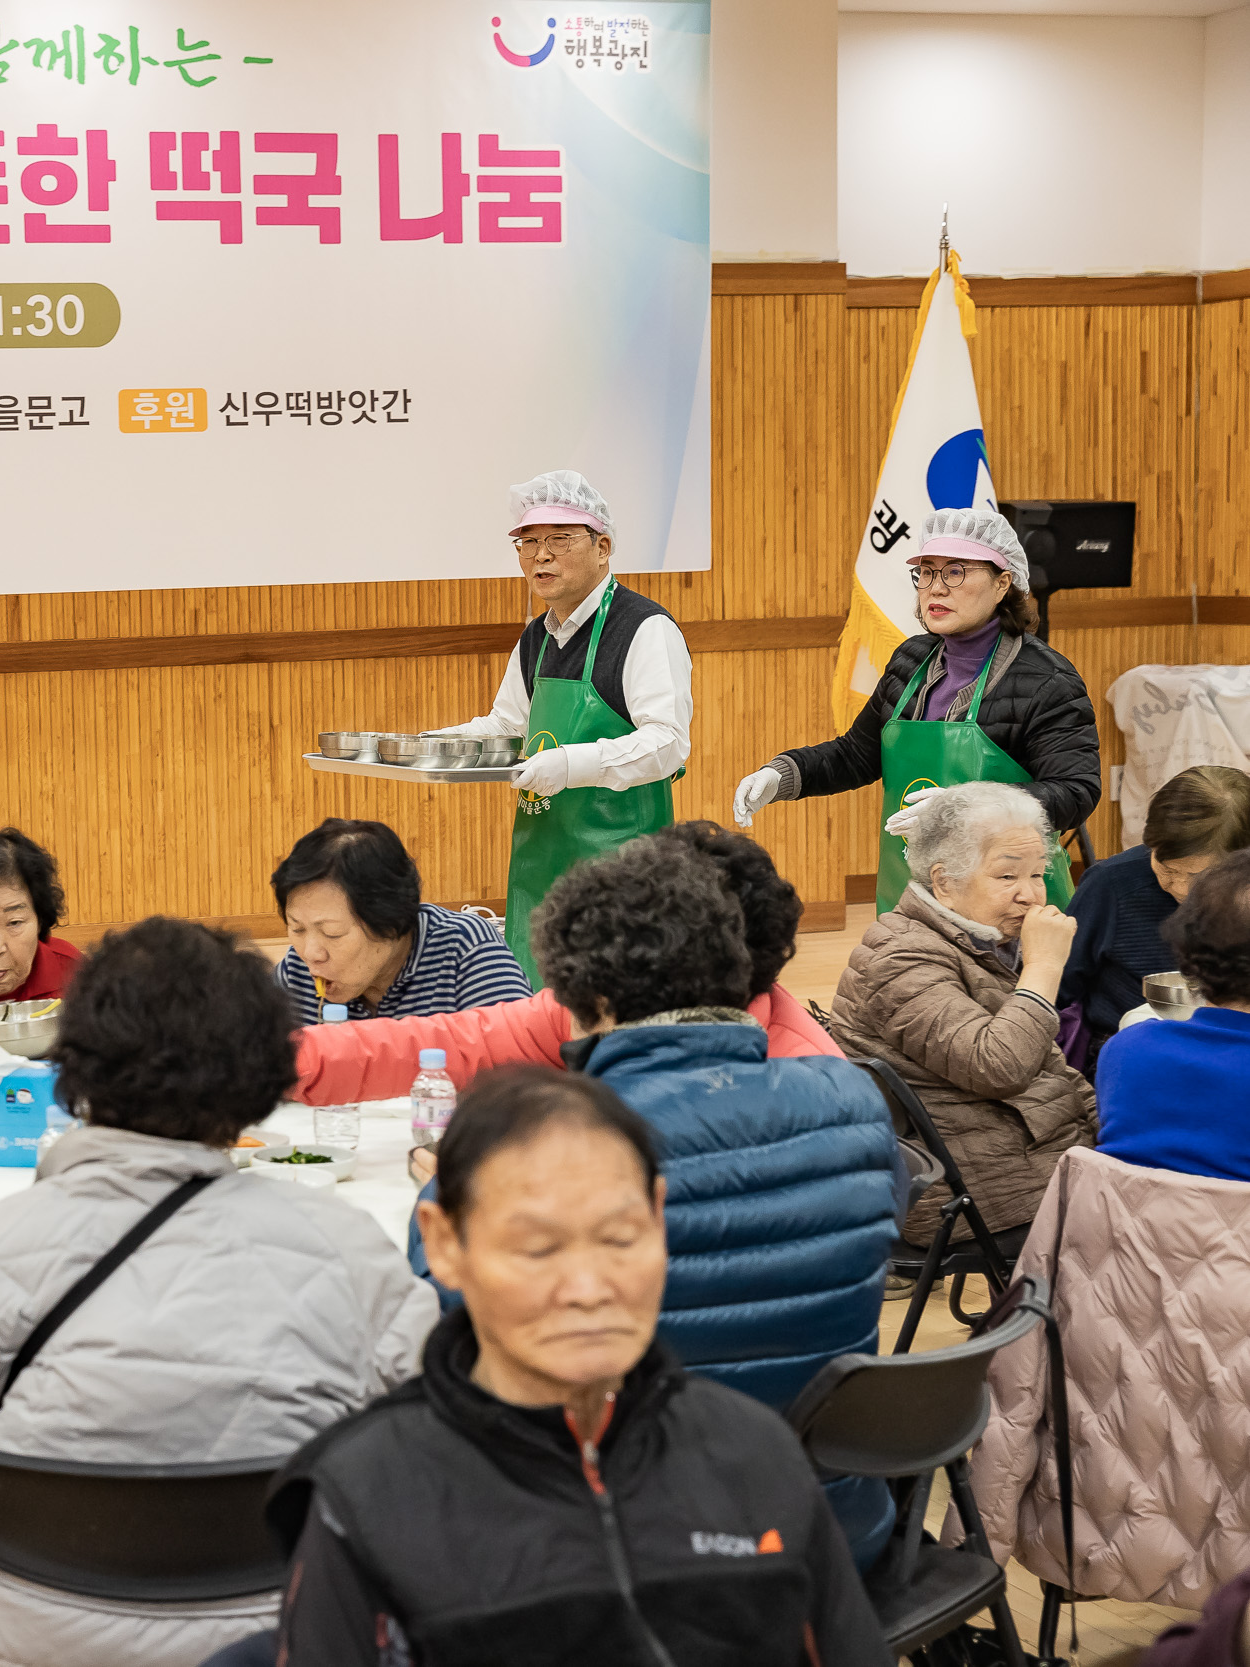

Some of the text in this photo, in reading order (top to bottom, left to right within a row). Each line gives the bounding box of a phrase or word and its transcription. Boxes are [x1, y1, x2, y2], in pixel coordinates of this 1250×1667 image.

[564, 17, 649, 38] 소통하며 발전하는
[564, 36, 648, 70] 행복광진
[149, 130, 342, 245] 떡국
[377, 132, 563, 244] 나눔
[131, 393, 196, 429] 후원
[218, 388, 412, 427] 신우떡방앗간
